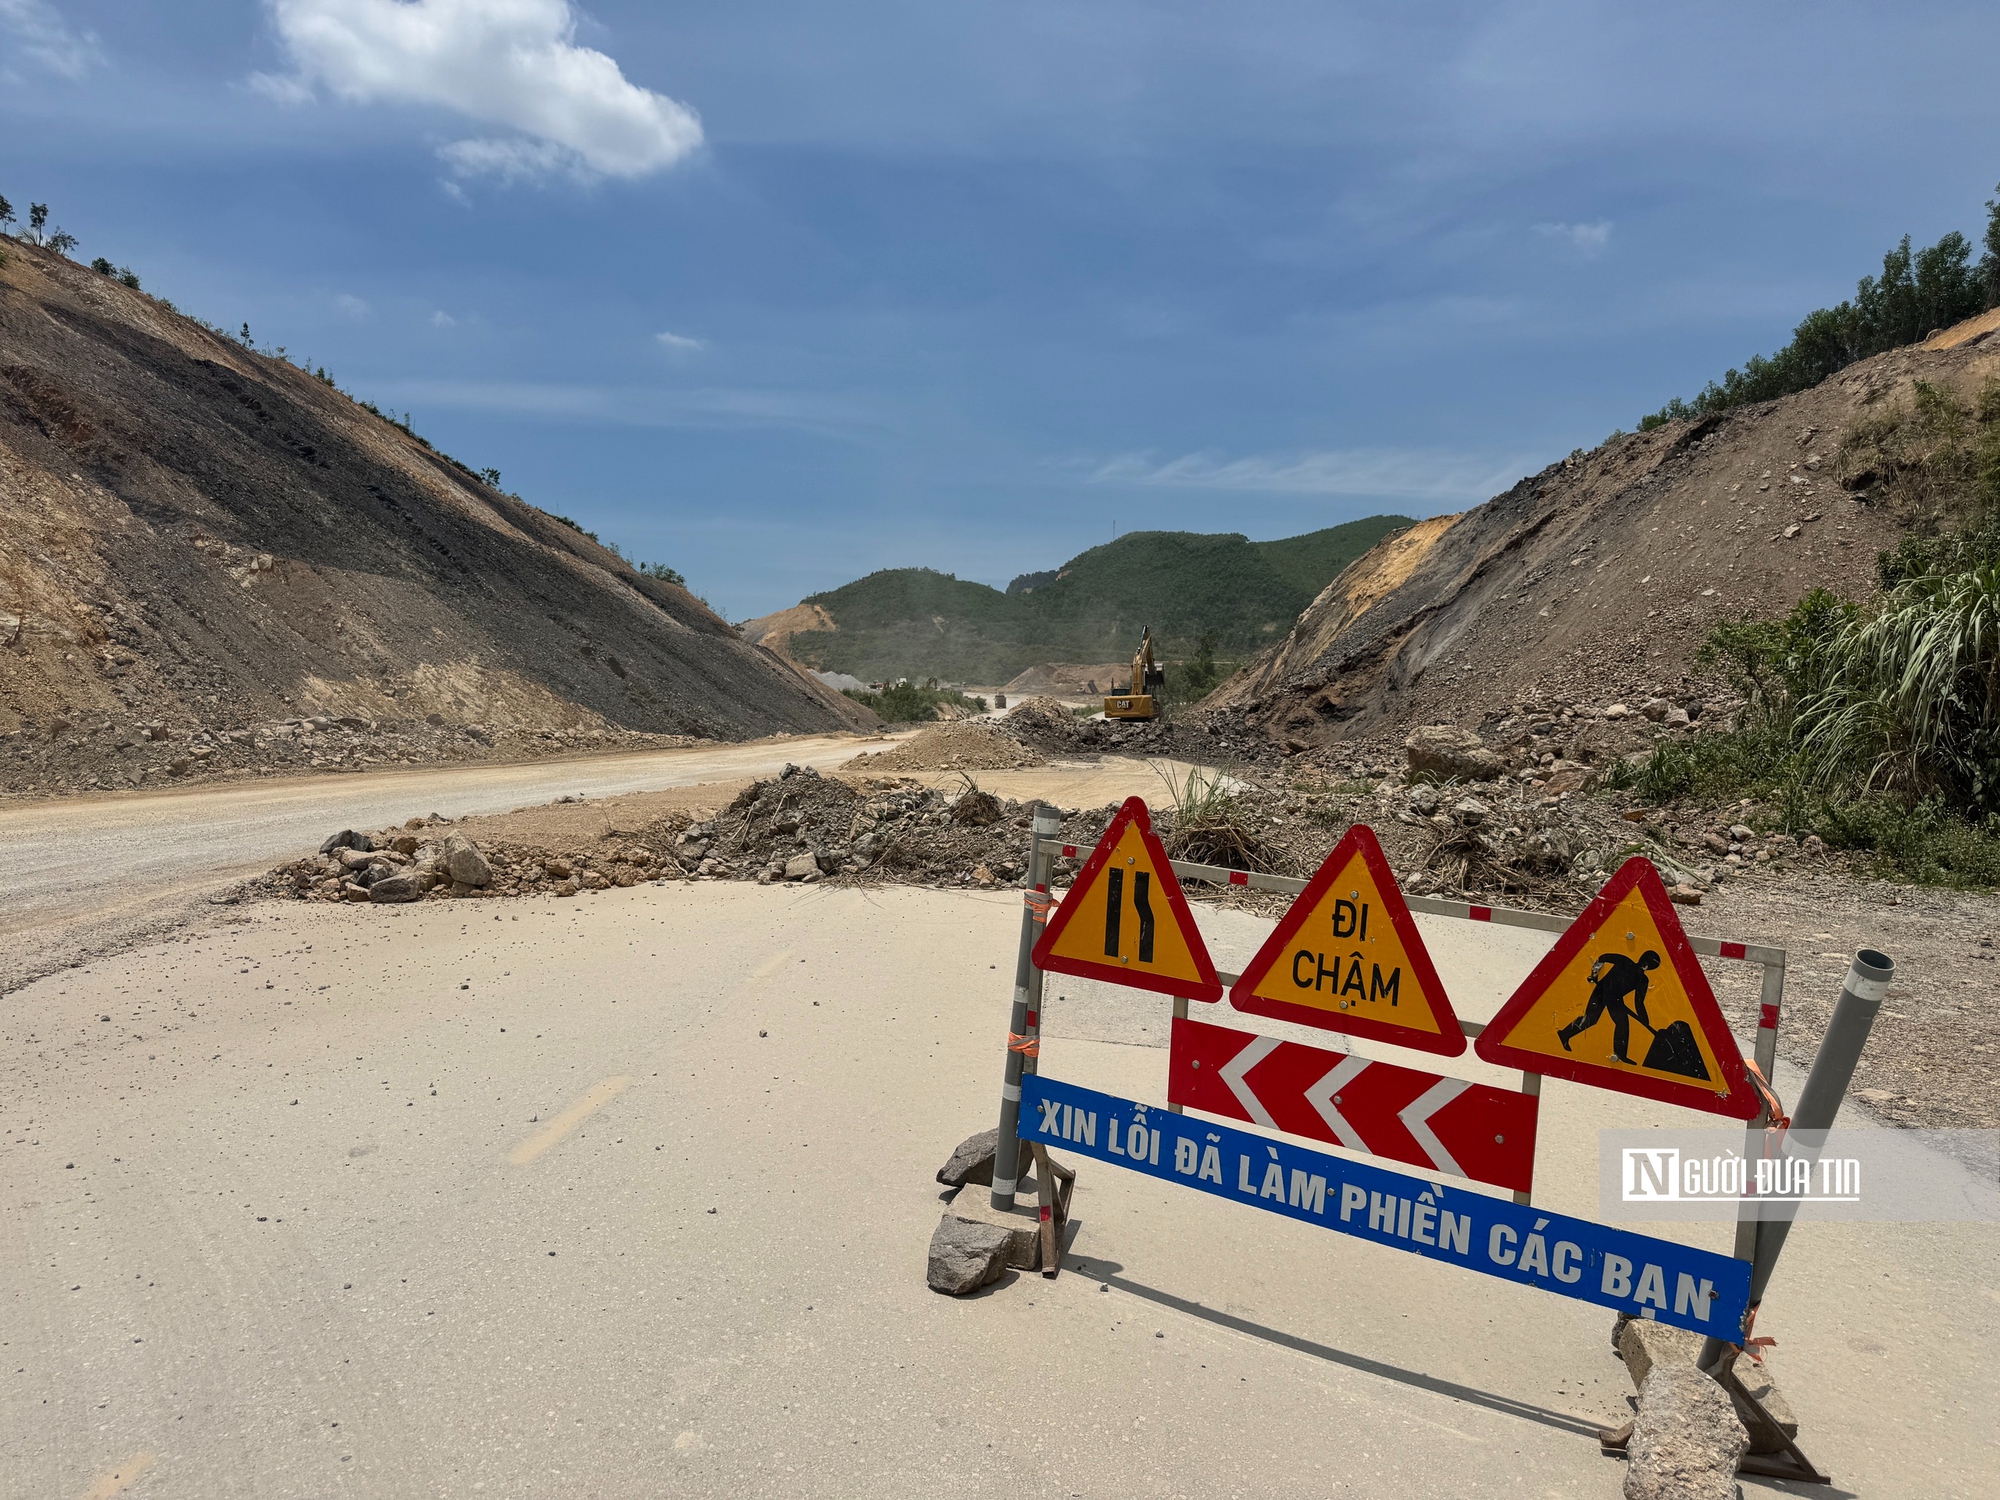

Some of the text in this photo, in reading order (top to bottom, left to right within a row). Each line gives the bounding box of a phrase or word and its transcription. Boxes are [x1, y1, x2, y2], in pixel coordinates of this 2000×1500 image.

[1116, 700, 1130, 708] CAT
[1332, 898, 1369, 942] ĐI
[1292, 950, 1401, 1007] CHẬM
[1038, 1098, 1714, 1322] XIN LỖI ĐÃ LÀM PHIỀN CÁC BẠN
